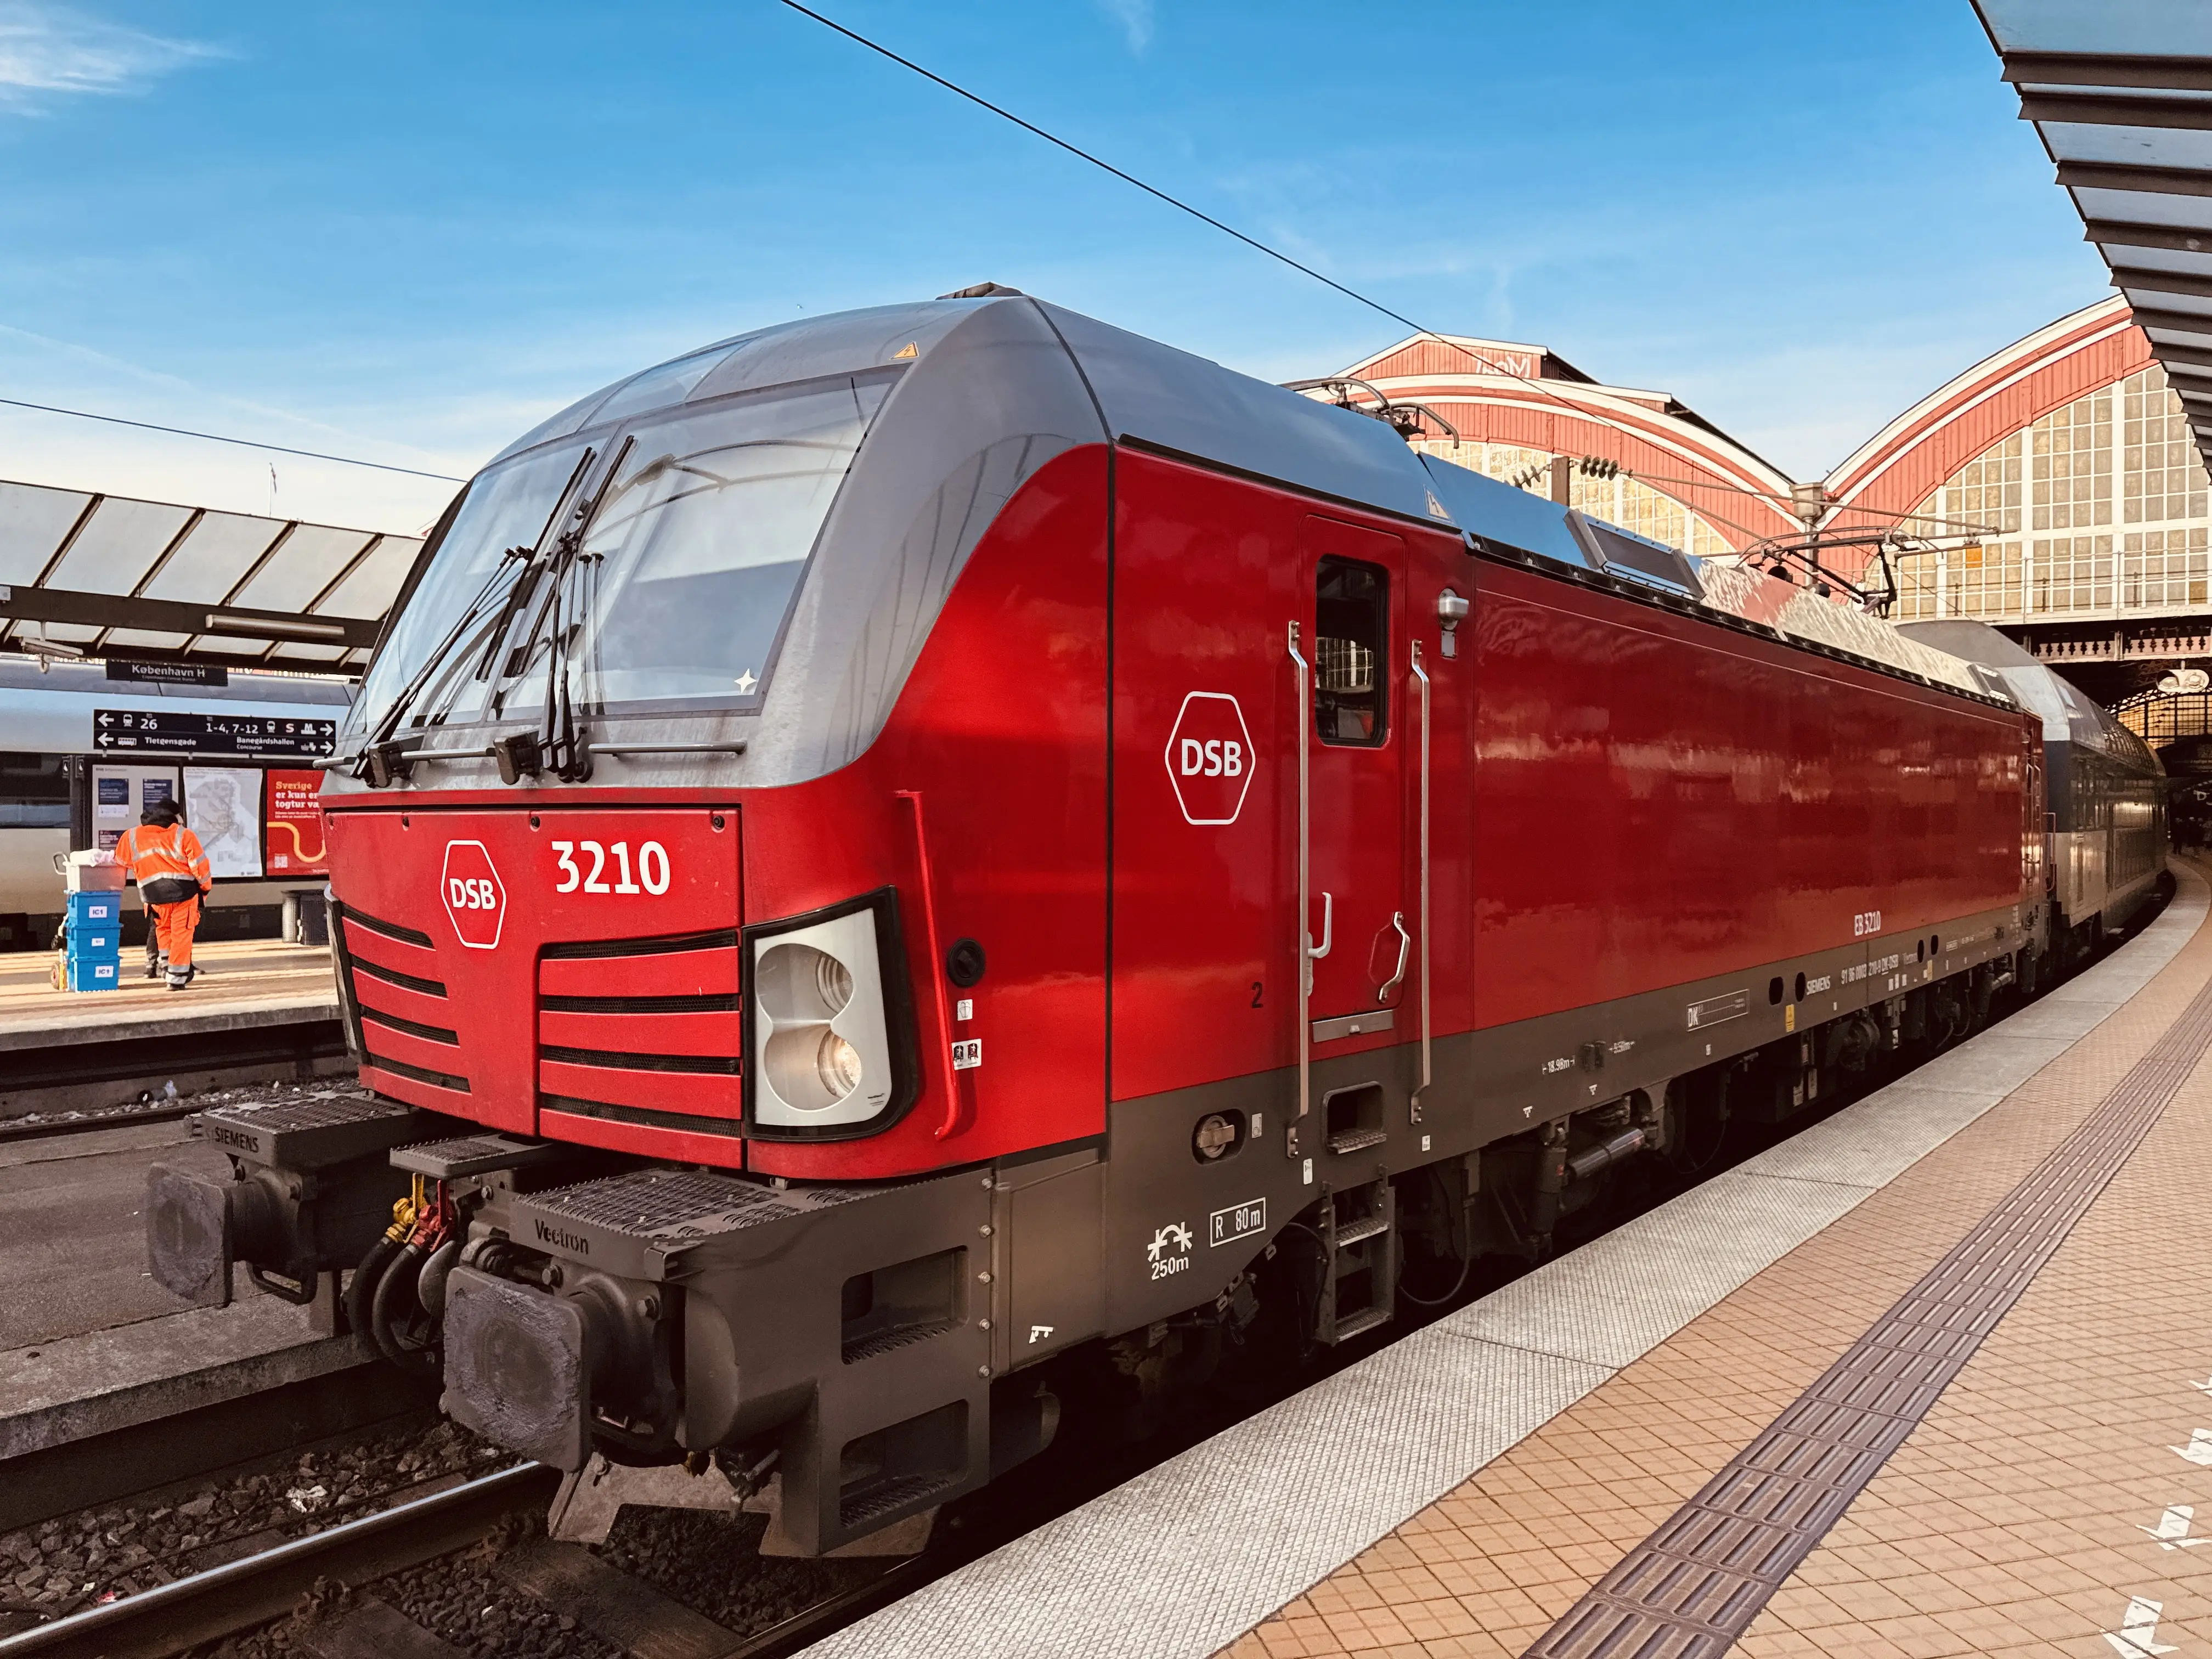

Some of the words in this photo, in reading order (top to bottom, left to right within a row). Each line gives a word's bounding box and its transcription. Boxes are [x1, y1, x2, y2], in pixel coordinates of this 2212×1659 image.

[132, 664, 194, 677] København
[197, 668, 205, 678] H
[140, 718, 157, 730] 26
[233, 724, 258, 734] 7-12
[144, 737, 196, 747] Tietgensgade
[236, 736, 295, 746] Banegårdshallen
[1182, 738, 1242, 777] DSB
[275, 781, 312, 791] Sverige
[287, 790, 307, 799] kun
[275, 800, 306, 809] togtur
[551, 840, 671, 895] 3210
[449, 878, 496, 910] DSB
[1854, 914, 1864, 936] EB
[1864, 910, 1881, 934] 3210
[1251, 982, 1263, 1009] 2
[1807, 975, 1831, 996] SIEMENS
[1688, 1006, 1699, 1028] DK
[215, 1126, 259, 1153] SIEMENS
[535, 1218, 589, 1255] Vectron
[1216, 1215, 1223, 1239] R
[1151, 1257, 1189, 1280] 250m
